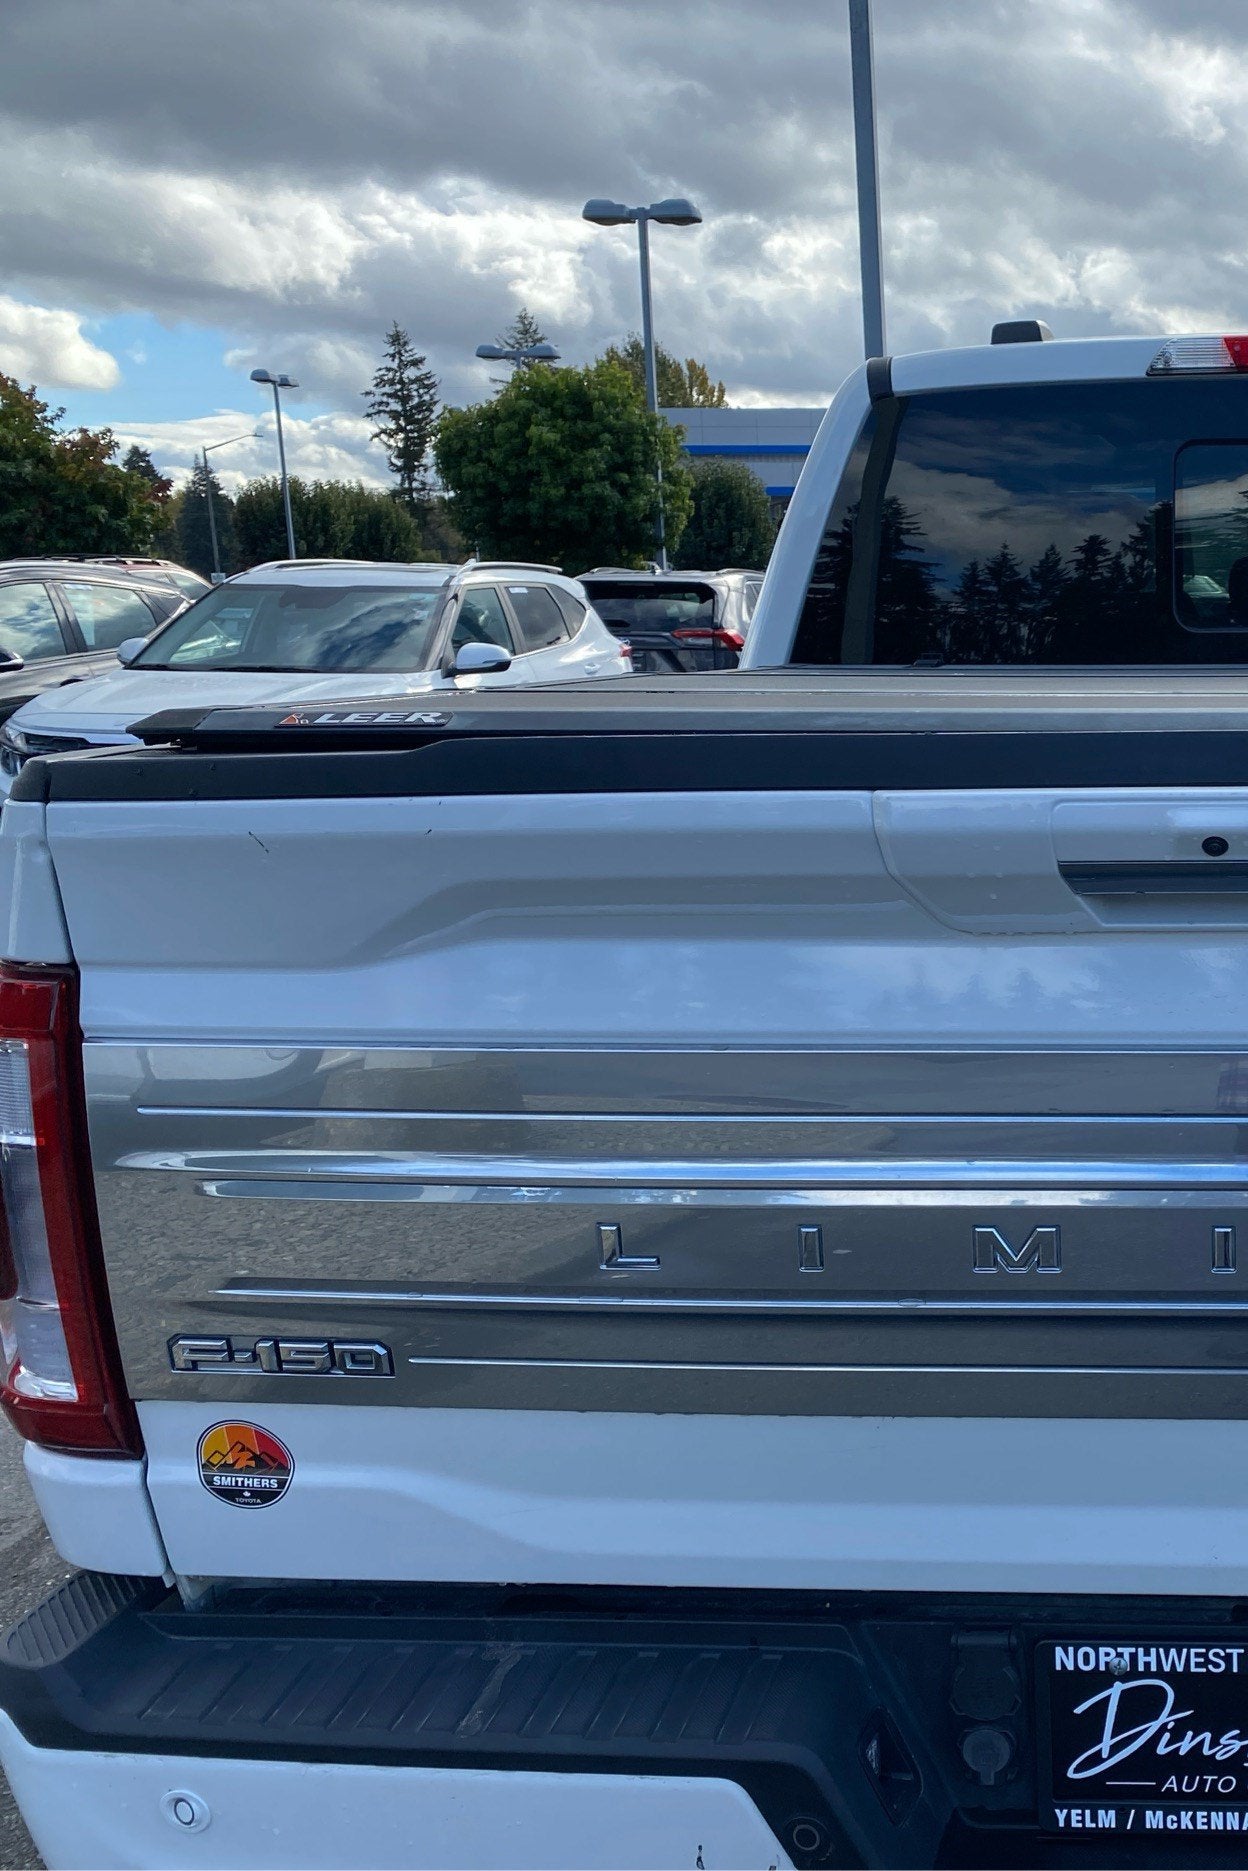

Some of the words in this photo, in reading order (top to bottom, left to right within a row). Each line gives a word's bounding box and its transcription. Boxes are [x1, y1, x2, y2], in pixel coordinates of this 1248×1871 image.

[313, 712, 442, 724] LEER
[167, 1333, 395, 1378] F-150
[213, 1476, 278, 1488] SMITHERS
[1055, 1646, 1245, 1673] NORTHWEST
[1161, 1775, 1237, 1794] AUTO
[1055, 1809, 1117, 1829] YELM
[1127, 1810, 1136, 1830] /
